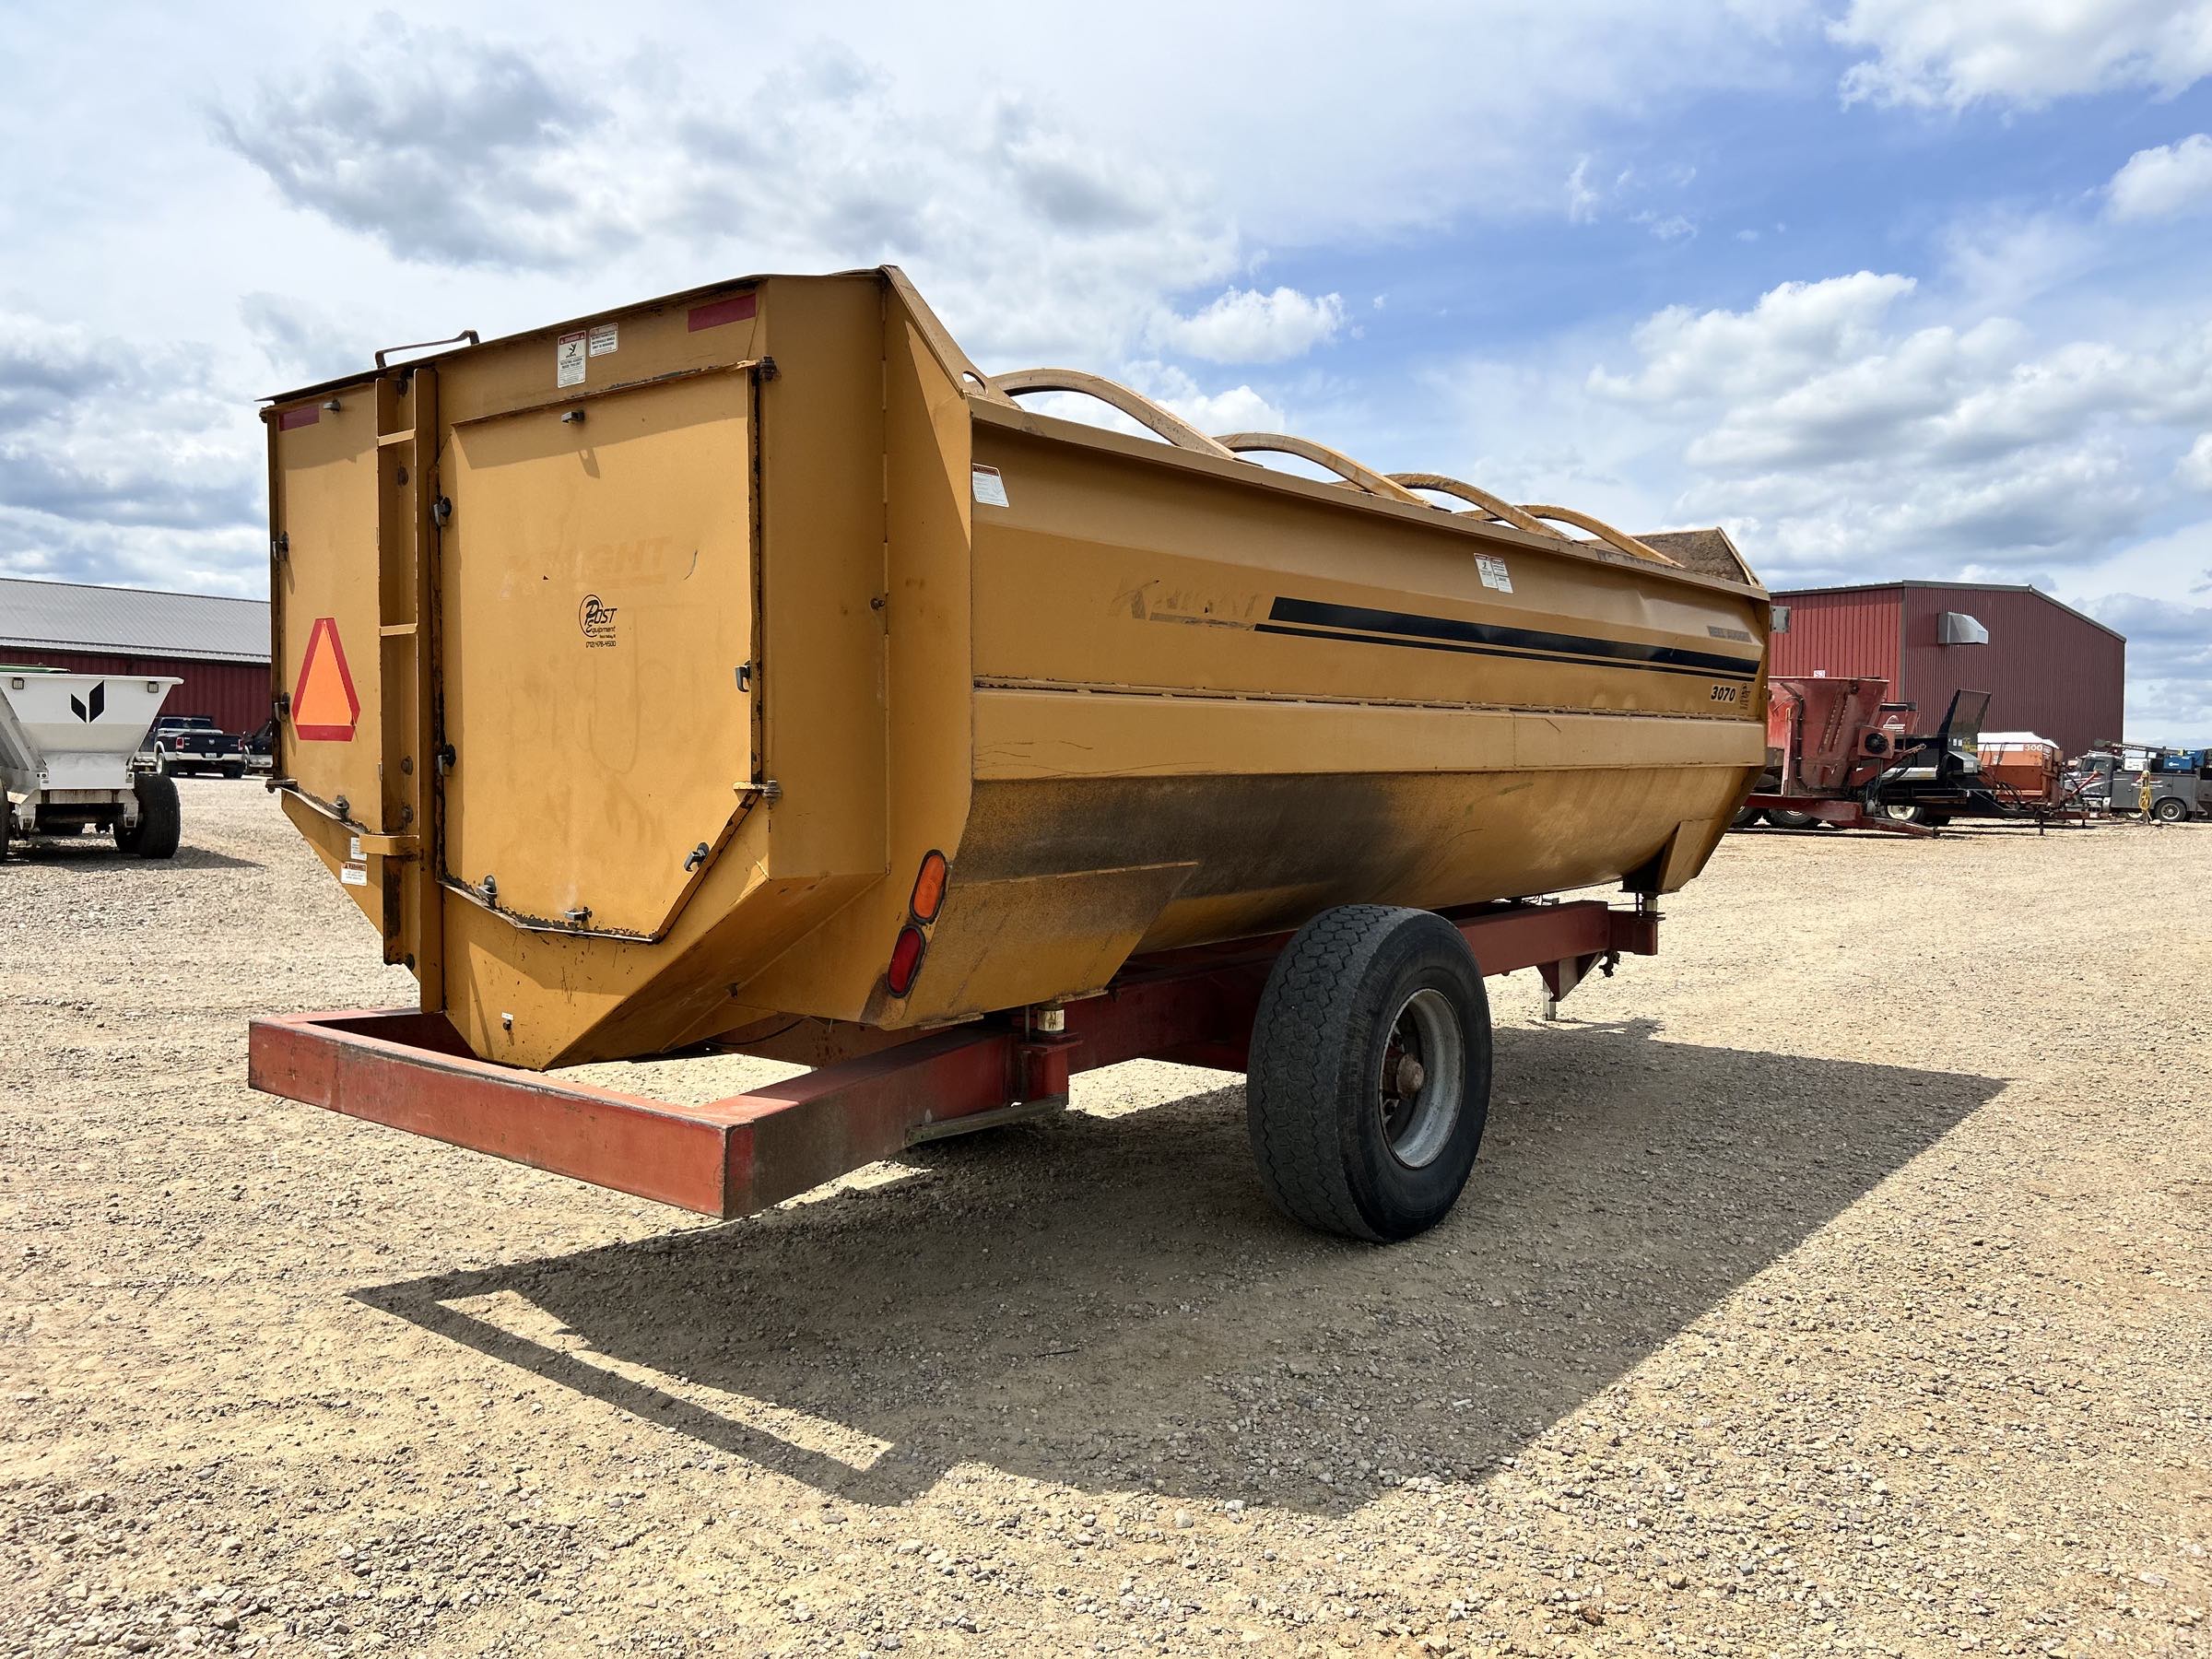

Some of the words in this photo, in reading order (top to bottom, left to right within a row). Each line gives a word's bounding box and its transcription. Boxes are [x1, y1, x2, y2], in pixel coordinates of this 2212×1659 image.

[584, 599, 618, 626] POST
[585, 619, 616, 634] Equipment
[1711, 686, 1735, 701] 3070
